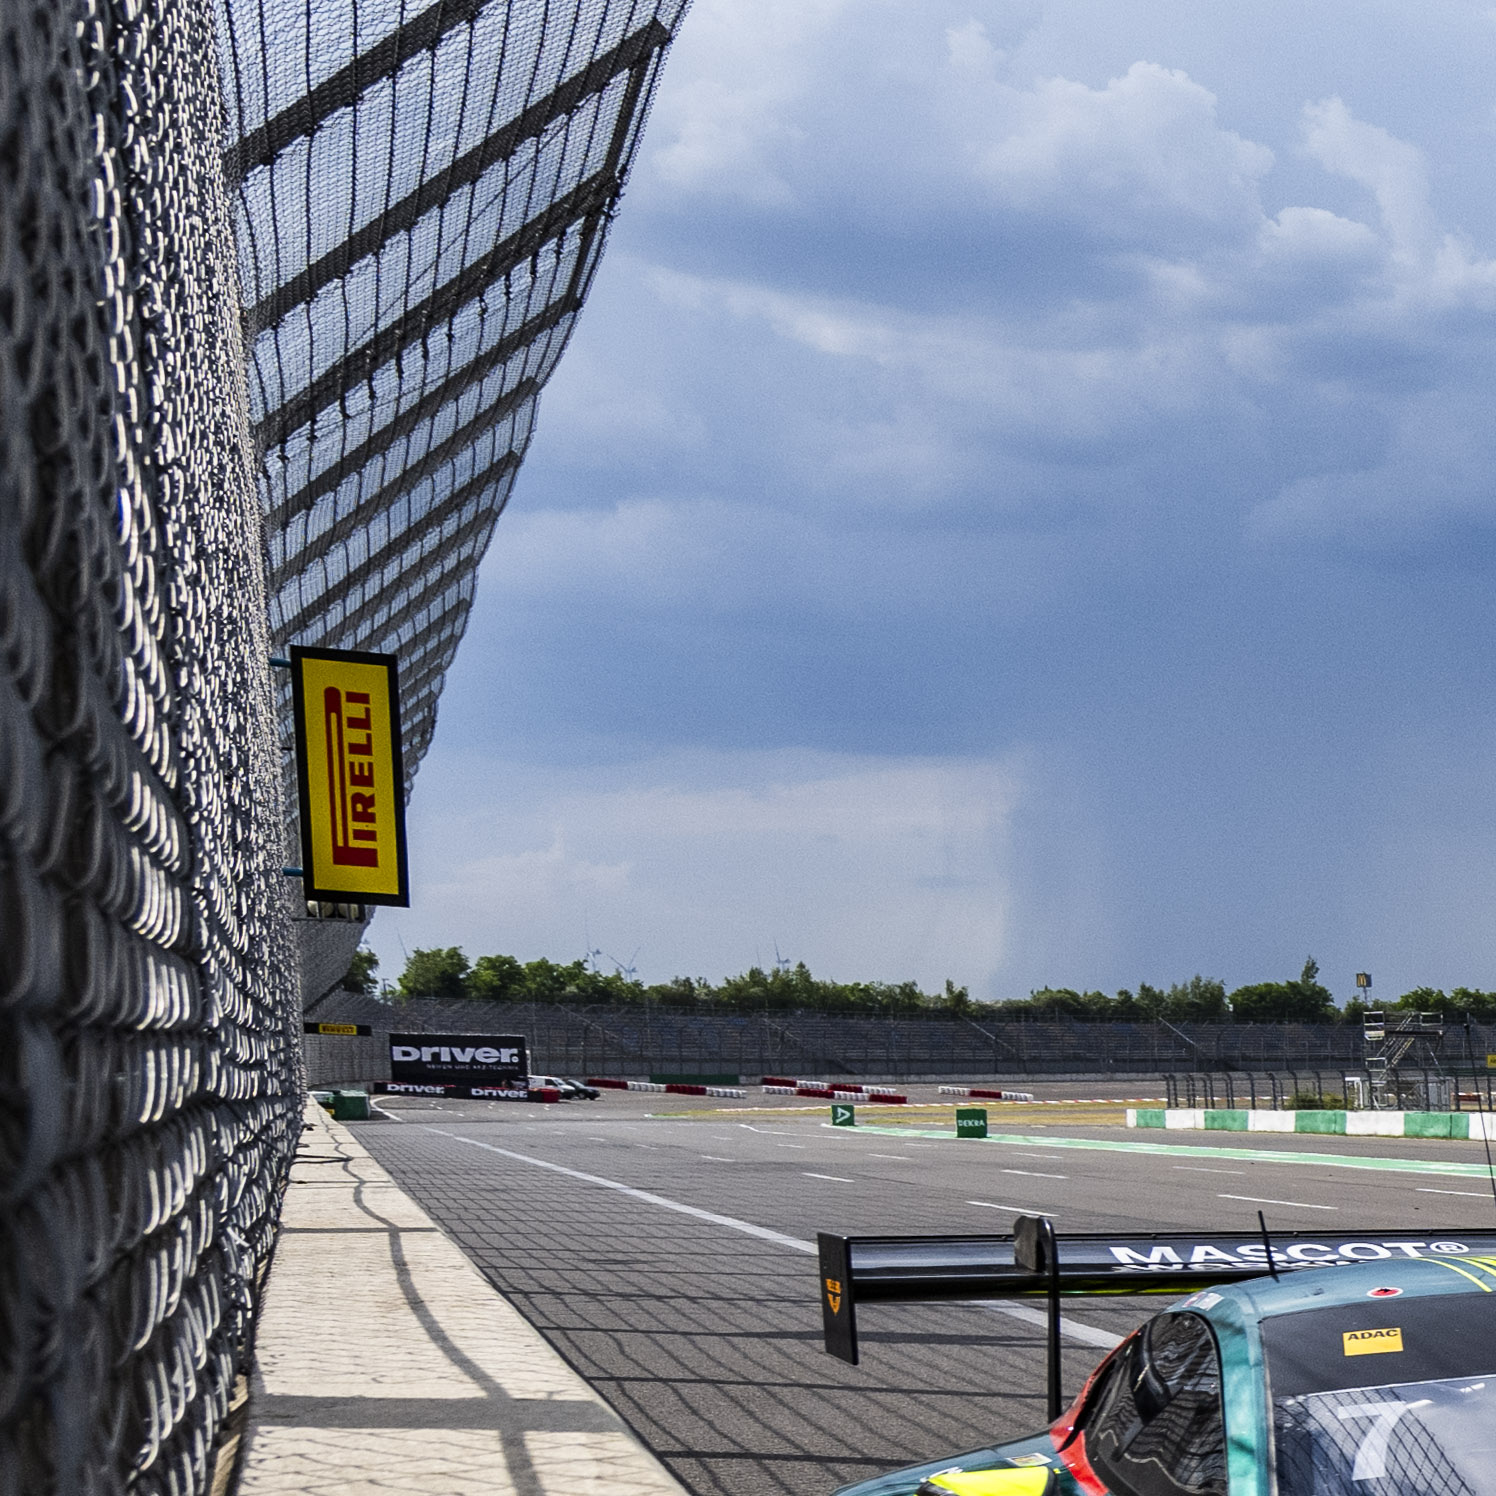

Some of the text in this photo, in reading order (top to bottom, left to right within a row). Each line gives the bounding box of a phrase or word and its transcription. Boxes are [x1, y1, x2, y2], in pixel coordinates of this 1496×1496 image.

[324, 686, 379, 868] PIRELLI
[1347, 1327, 1399, 1341] ADAC
[1338, 1401, 1407, 1481] 7
